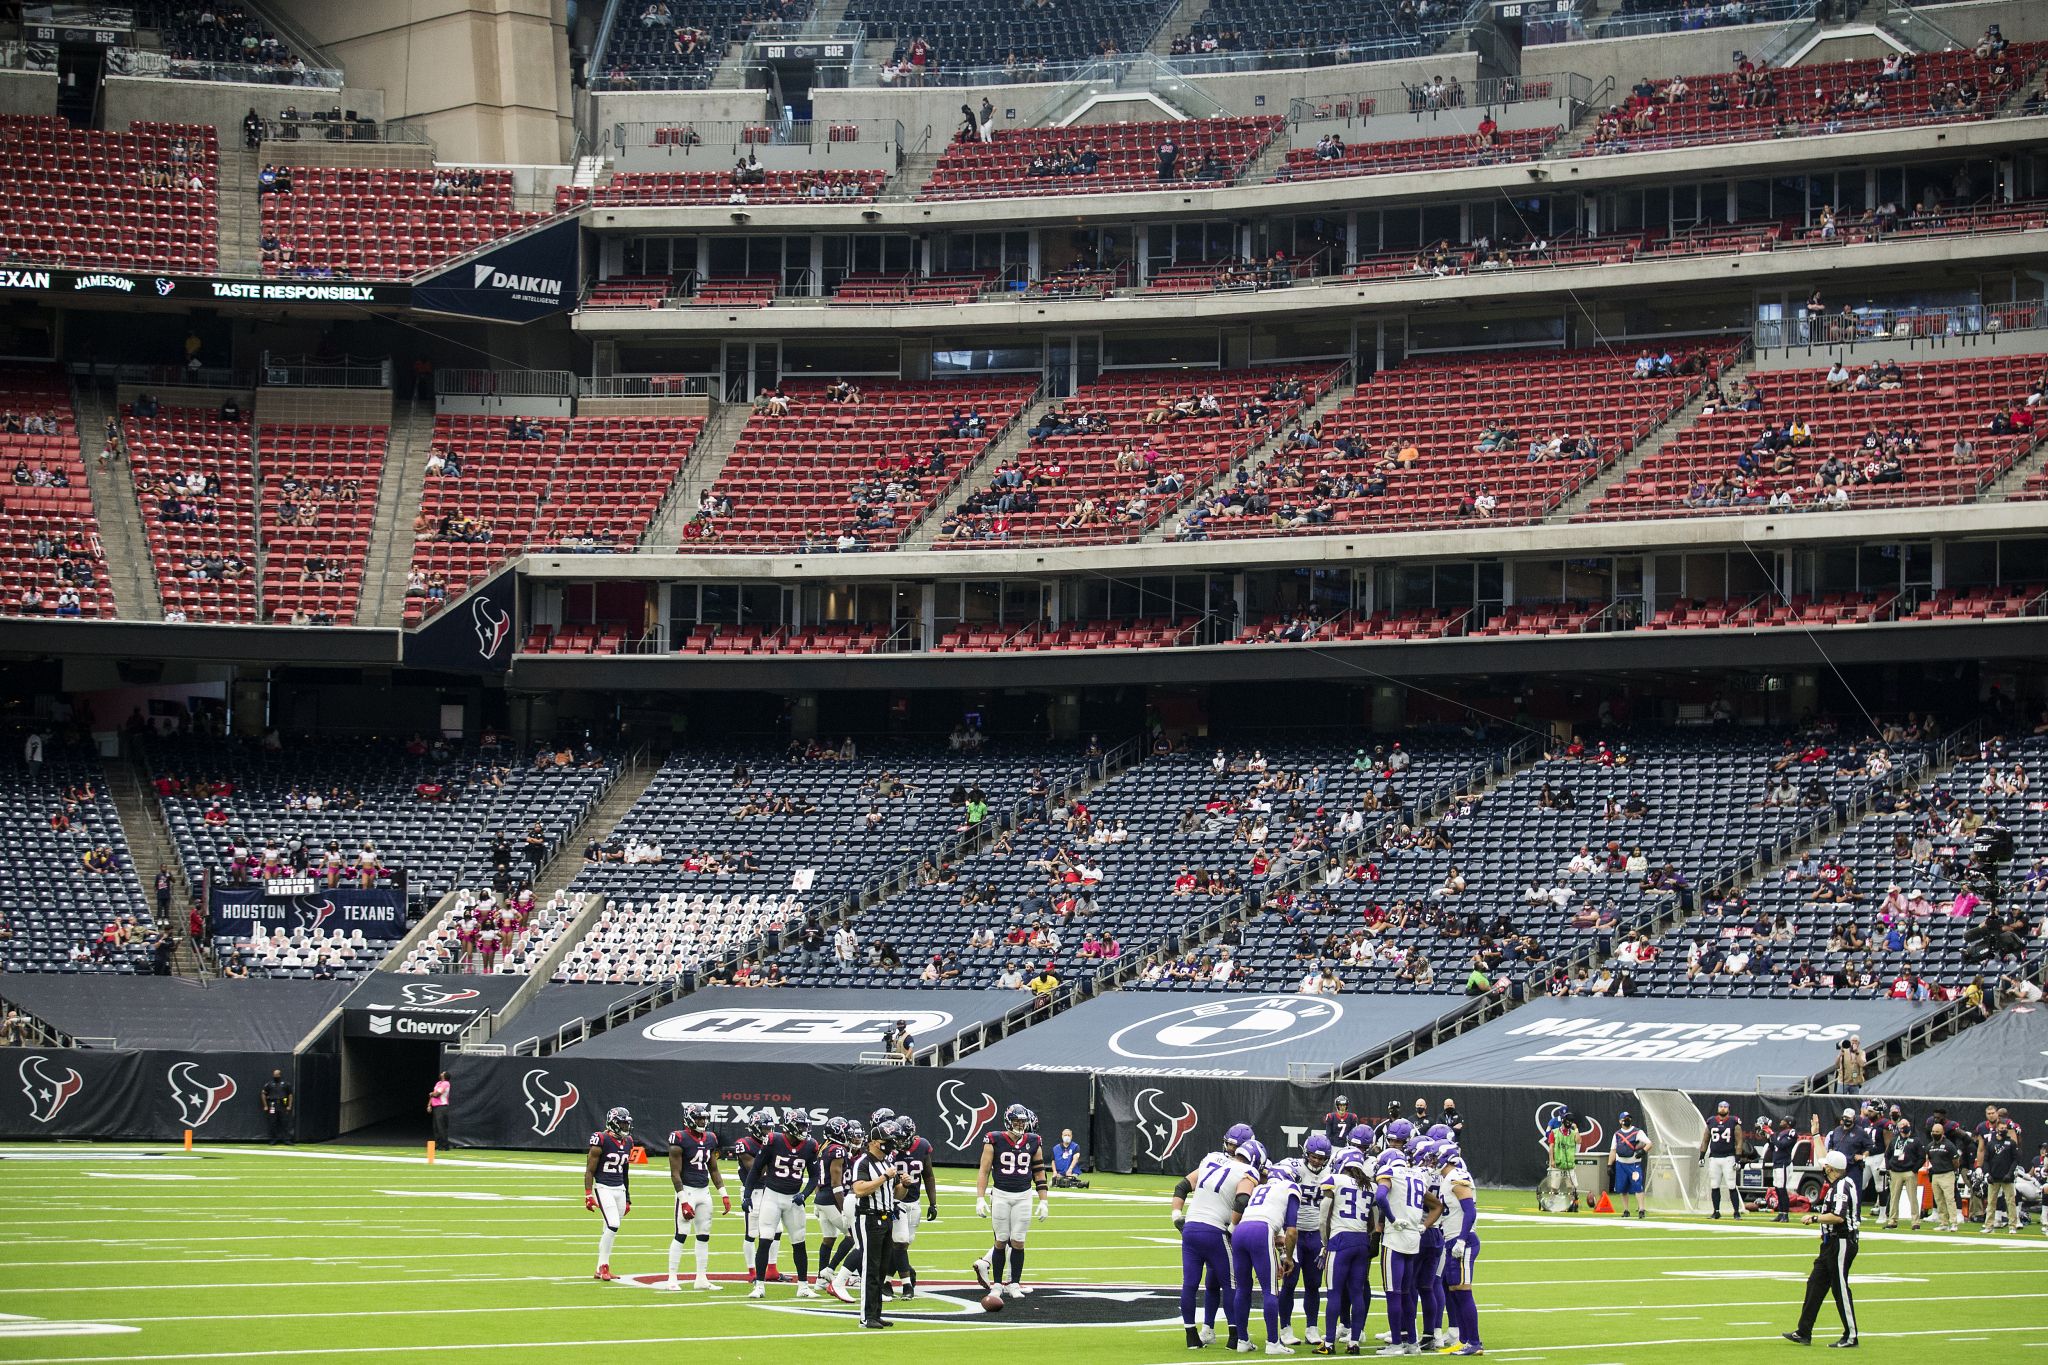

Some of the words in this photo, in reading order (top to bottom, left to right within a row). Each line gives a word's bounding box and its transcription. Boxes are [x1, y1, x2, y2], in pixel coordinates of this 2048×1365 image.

[1503, 5, 1521, 17] 603
[37, 28, 55, 39] 651
[95, 32, 115, 43] 652
[768, 46, 786, 58] 601
[824, 45, 844, 57] 602
[74, 275, 134, 292] JAMESON
[212, 283, 260, 298] TASTE
[263, 285, 374, 300] RESPONSIBLY.
[492, 272, 562, 295] DAIKIN
[511, 293, 521, 301] AIR
[522, 295, 560, 305] INTELLIGENCE
[1866, 438, 1876, 447] 99
[1825, 869, 1837, 878] 99
[268, 878, 315, 886] NOISES
[268, 885, 315, 894] LOUD
[222, 904, 286, 919] HOUSTON
[343, 905, 395, 921] TEXANS
[1192, 998, 1330, 1017] BMW
[1505, 1017, 1861, 1042] MATTRESS
[1535, 1038, 1751, 1060] FIRM
[721, 1092, 792, 1102] HOUSTON
[1337, 1123, 1347, 1138] 7
[1710, 1127, 1732, 1143] 64
[589, 1135, 600, 1146] 20
[735, 1142, 745, 1154] 23
[690, 1150, 711, 1170] 41
[774, 1155, 806, 1179] 59
[1000, 1151, 1031, 1175] 99
[1198, 1161, 1231, 1193] 71
[1250, 1186, 1271, 1206] 8
[1405, 1176, 1425, 1210] 18
[1339, 1187, 1375, 1222] 33
